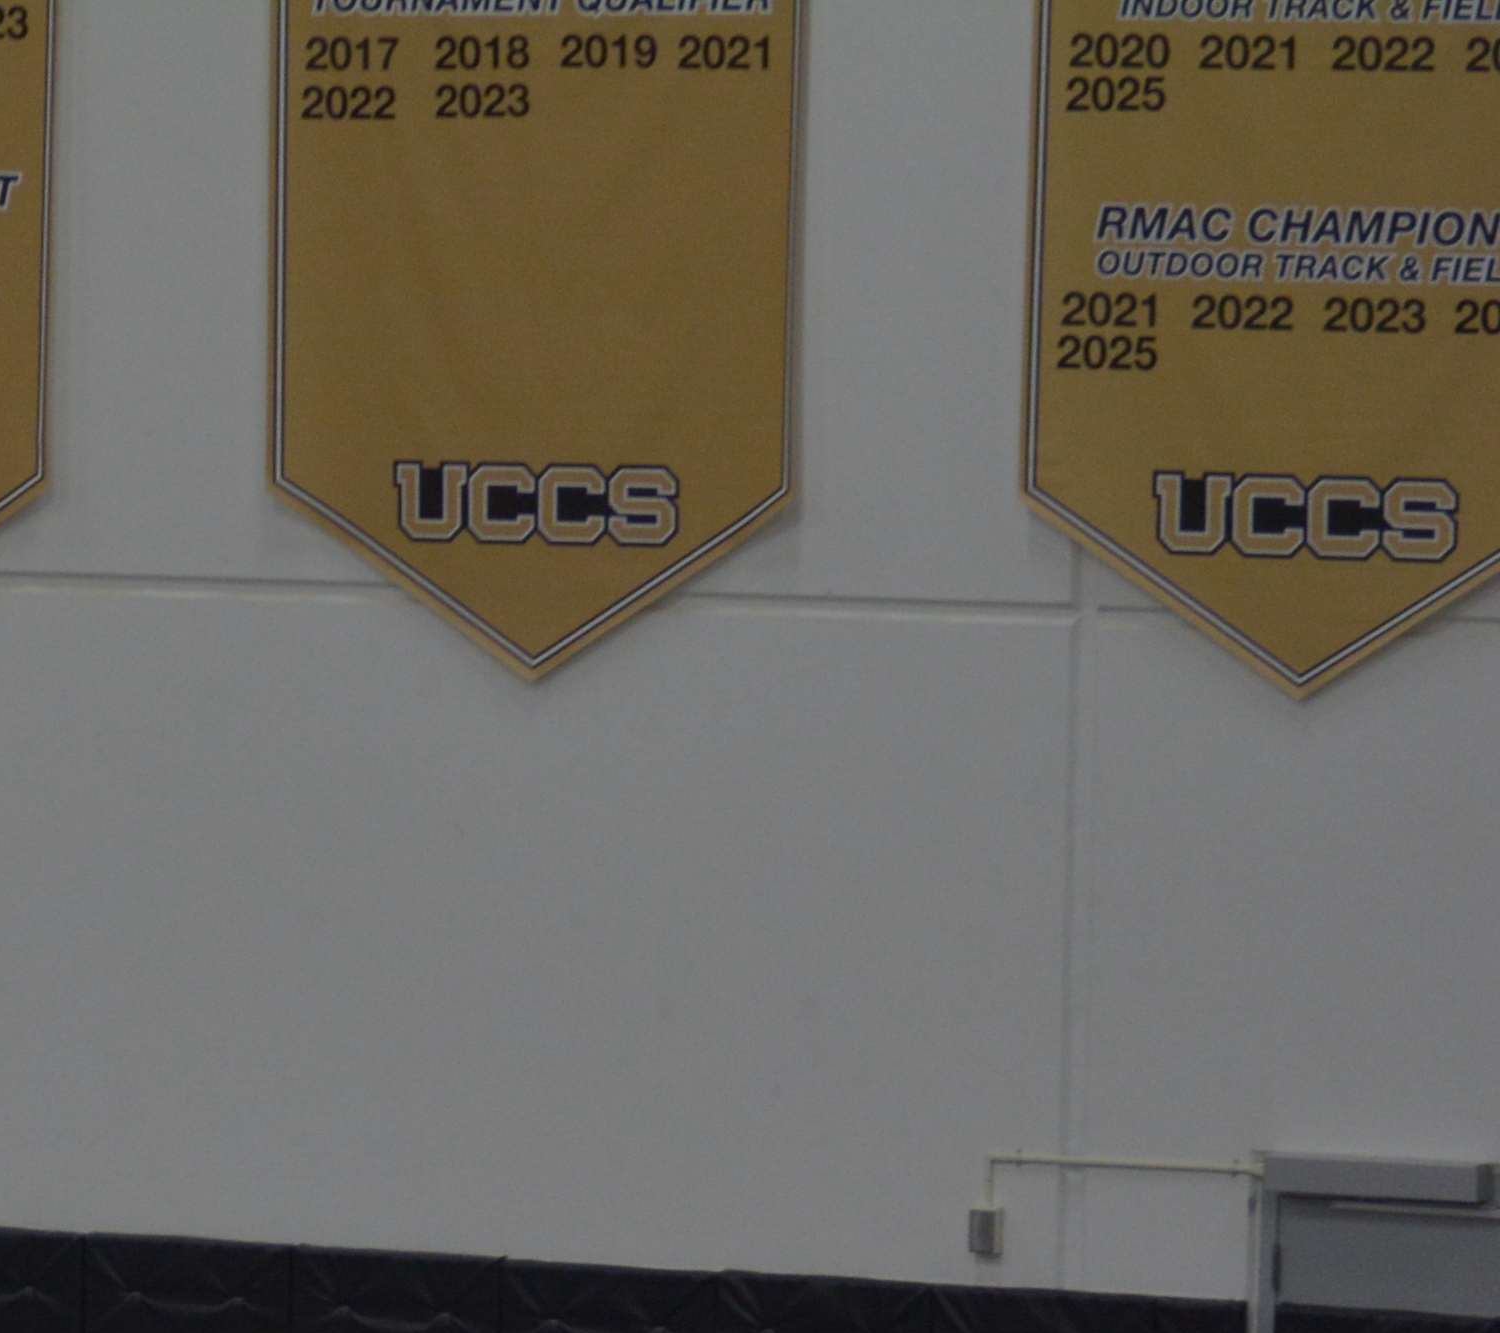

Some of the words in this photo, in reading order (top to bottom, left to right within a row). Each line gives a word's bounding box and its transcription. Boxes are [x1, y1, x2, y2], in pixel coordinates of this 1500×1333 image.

[1421, 0, 1500, 20] FIEL
[304, 36, 400, 71] 2017
[434, 36, 530, 71] 2018
[560, 34, 658, 70] 2019
[678, 35, 772, 70] 2021
[1069, 32, 1170, 69] 2020
[1200, 34, 1296, 70] 2021
[1331, 35, 1435, 72] 2022
[301, 85, 396, 120] 2022
[434, 84, 530, 119] 2023
[1066, 76, 1166, 112] 2025
[1096, 206, 1234, 244] RMAC
[1096, 251, 1263, 278] OUTDOOR
[1275, 252, 1387, 282] TRACK
[1398, 256, 1420, 282] &
[1061, 292, 1159, 328] 2021
[1191, 294, 1295, 331] 2022
[1323, 298, 1427, 334] 2023
[1057, 335, 1158, 370] 2025
[393, 460, 680, 547] UCCS
[1154, 470, 1459, 562] UCCS
